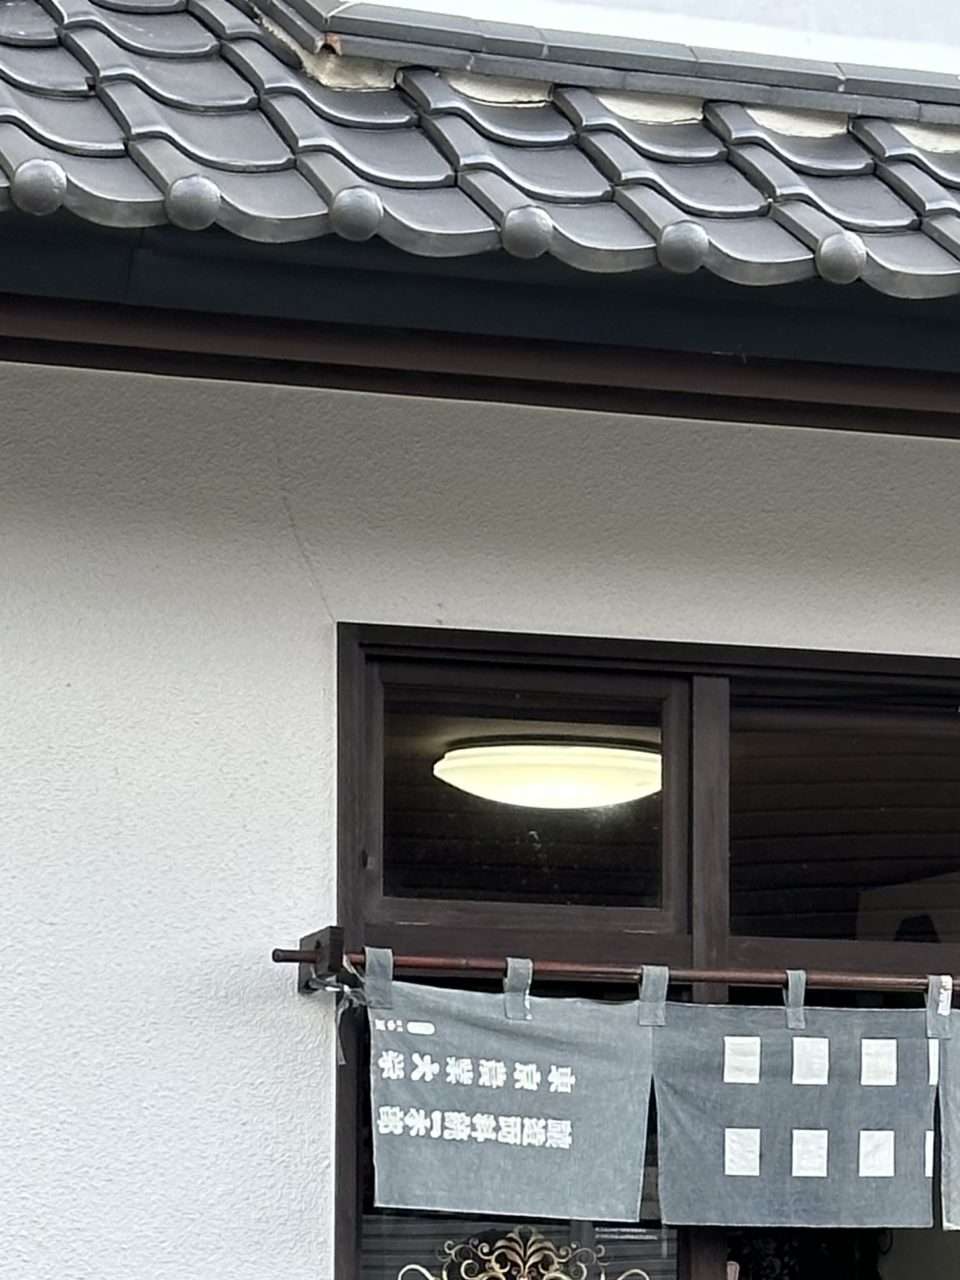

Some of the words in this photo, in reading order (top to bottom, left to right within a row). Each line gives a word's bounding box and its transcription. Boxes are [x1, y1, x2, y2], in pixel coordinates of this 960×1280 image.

[378, 1051, 576, 1094] 東京農業大学
